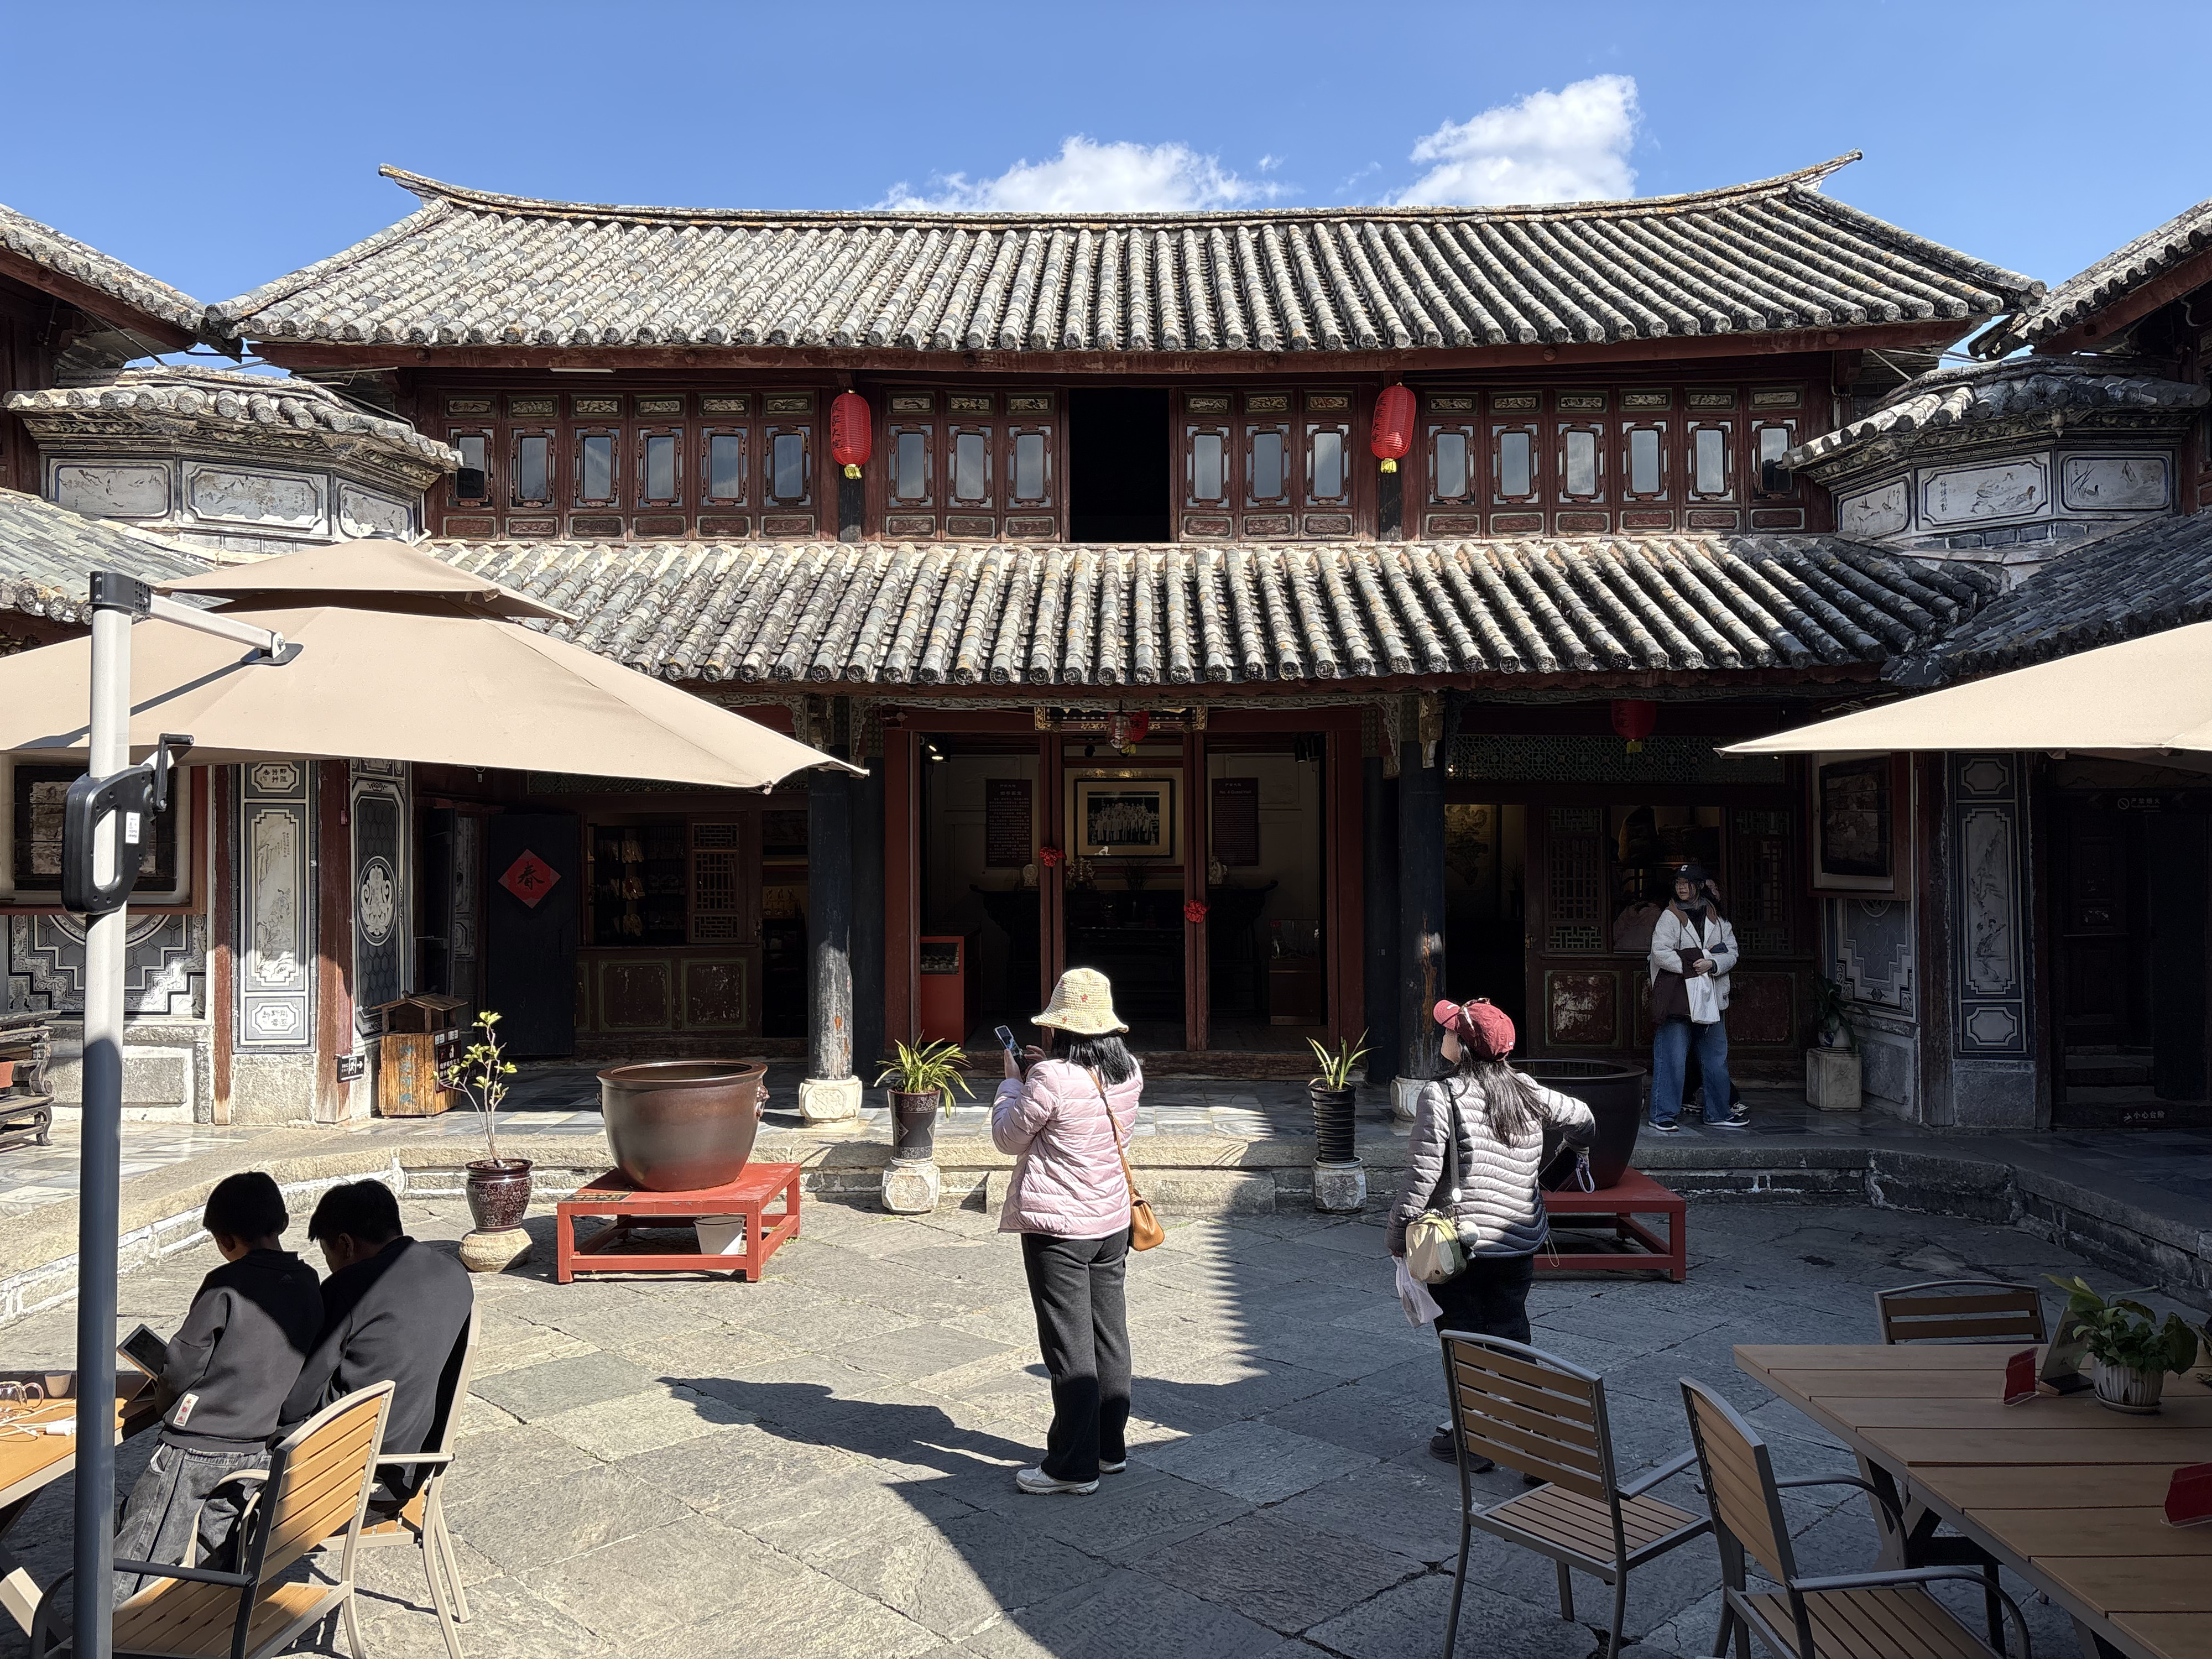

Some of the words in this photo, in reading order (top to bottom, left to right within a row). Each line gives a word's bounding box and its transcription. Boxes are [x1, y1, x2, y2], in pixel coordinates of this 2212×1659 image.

[517, 860, 545, 890] 春
[2133, 1110, 2166, 1119] 小心台阶
